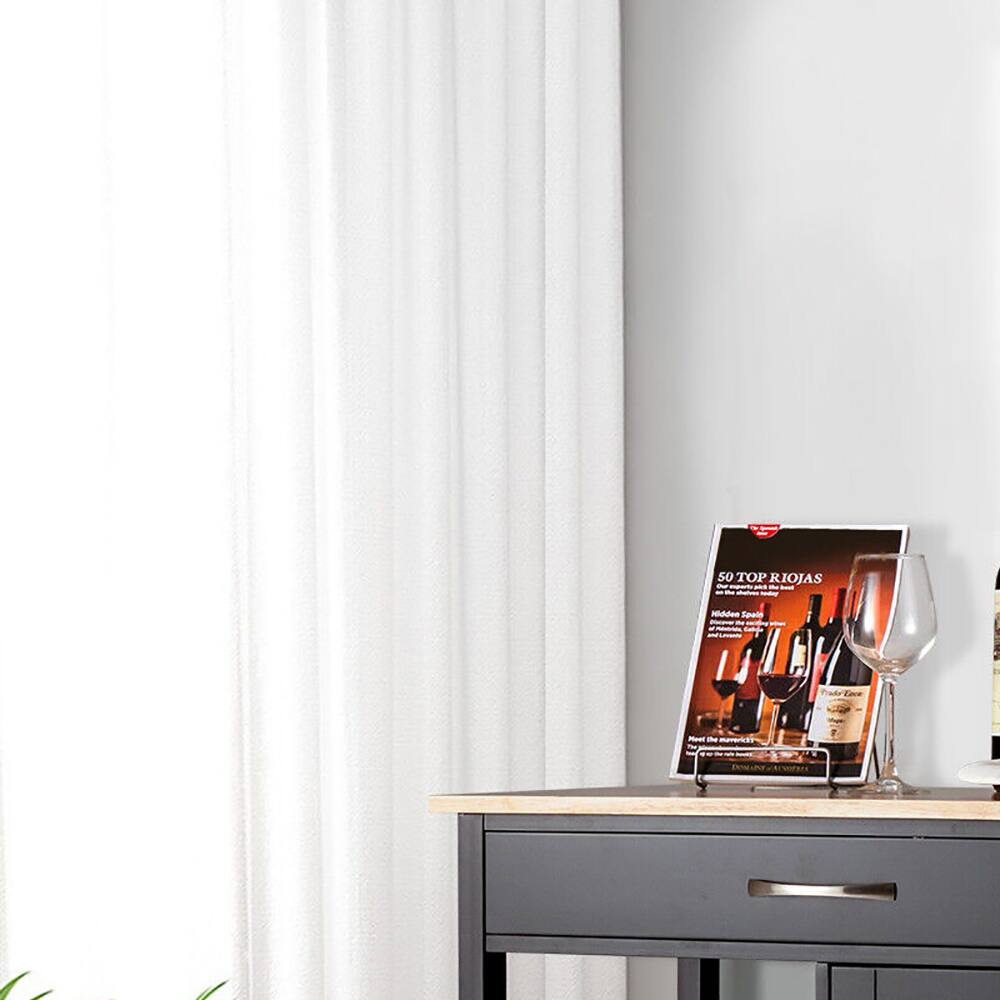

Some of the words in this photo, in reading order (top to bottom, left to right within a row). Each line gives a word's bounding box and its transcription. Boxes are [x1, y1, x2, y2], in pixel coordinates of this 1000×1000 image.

[717, 571, 734, 583] 50
[736, 571, 767, 583] TOP
[769, 572, 823, 585] RIOJAS
[711, 610, 740, 618] Hidden
[741, 611, 764, 619] Spain
[688, 735, 706, 743] Meet
[706, 735, 719, 743] the
